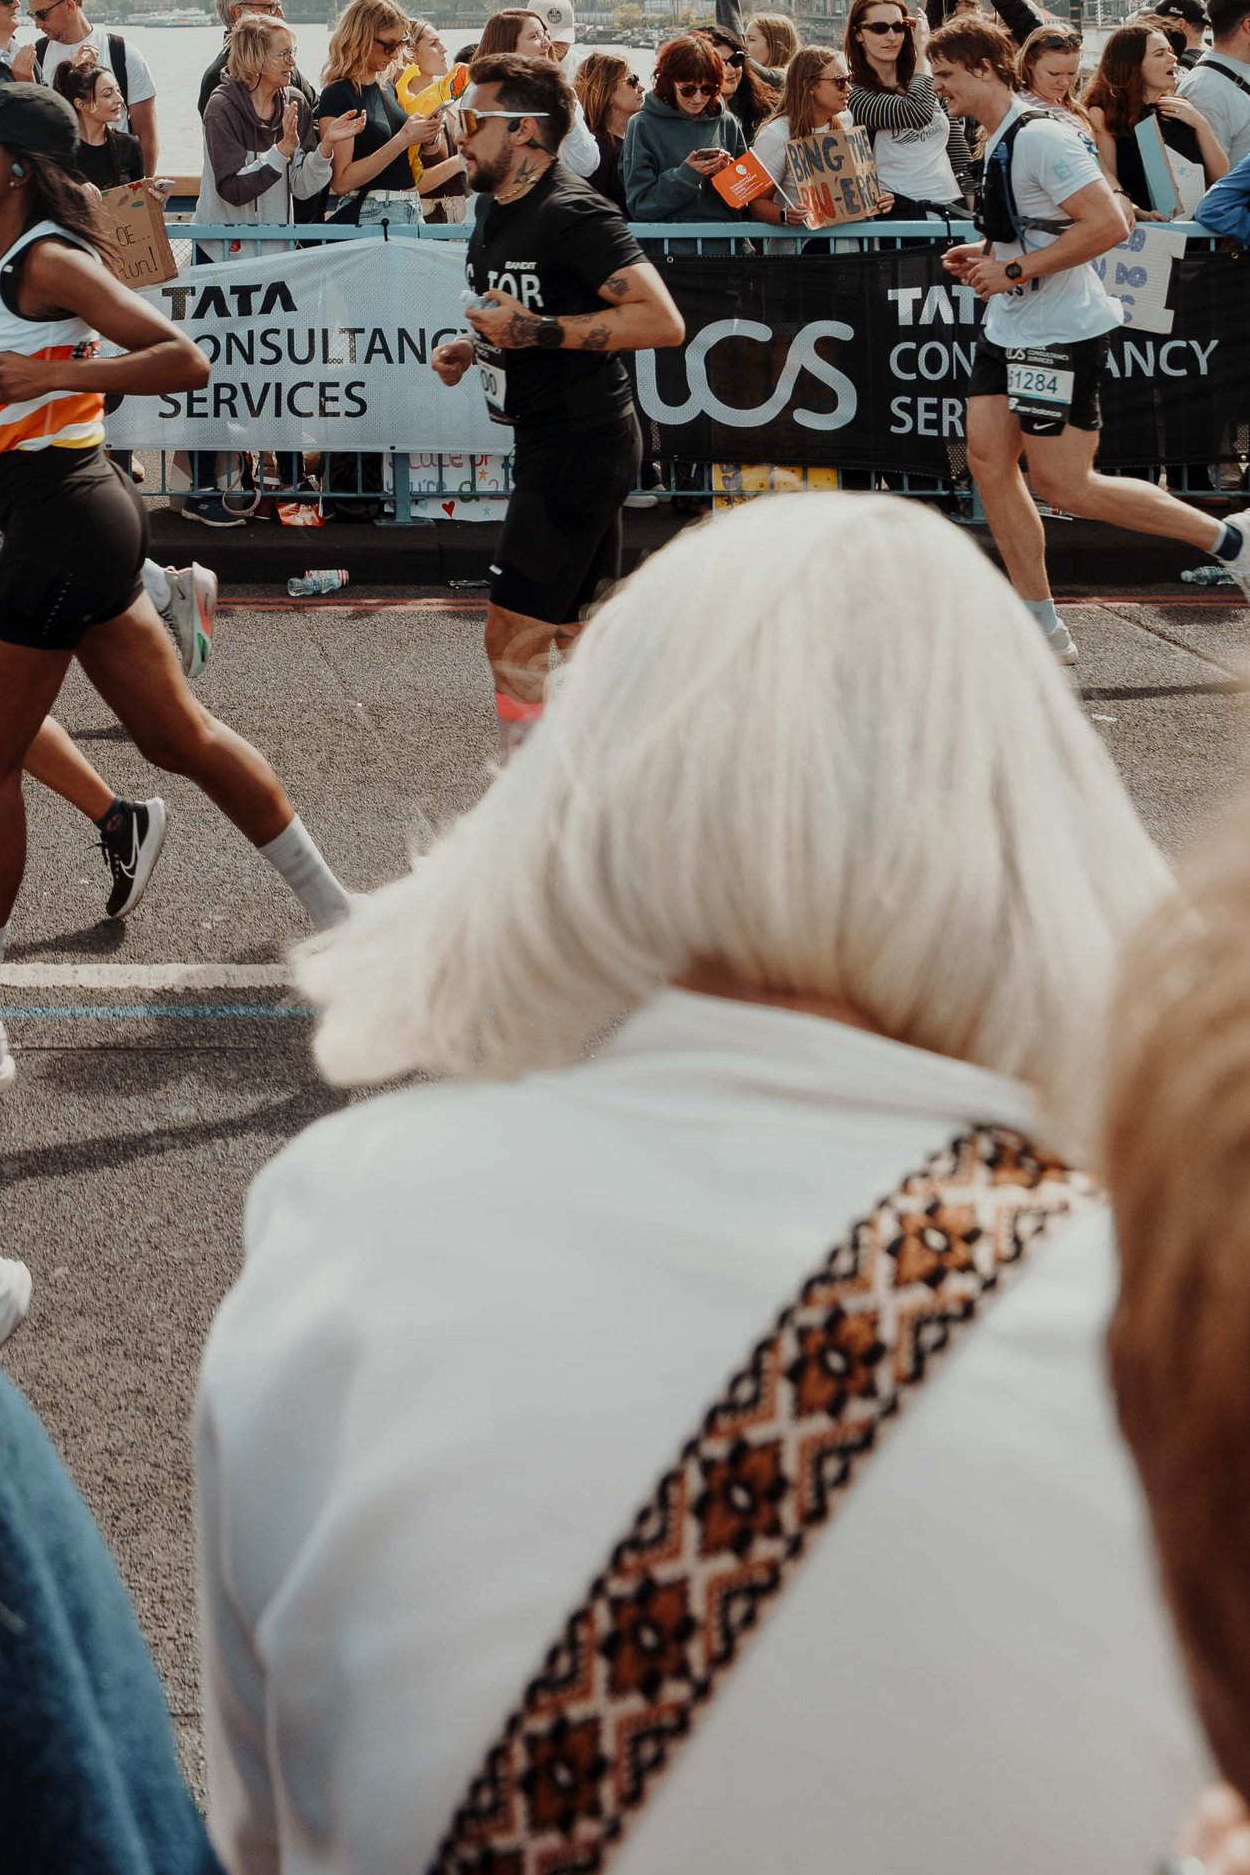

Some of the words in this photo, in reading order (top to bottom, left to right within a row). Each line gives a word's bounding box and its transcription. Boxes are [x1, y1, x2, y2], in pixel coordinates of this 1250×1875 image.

[844, 129, 874, 164] THE
[162, 280, 298, 321] TATA
[888, 285, 990, 326] TAT
[197, 327, 468, 366] ONSULTANC
[158, 380, 368, 420] SERVICES
[890, 395, 967, 438] SER
[386, 478, 447, 509] yu're
